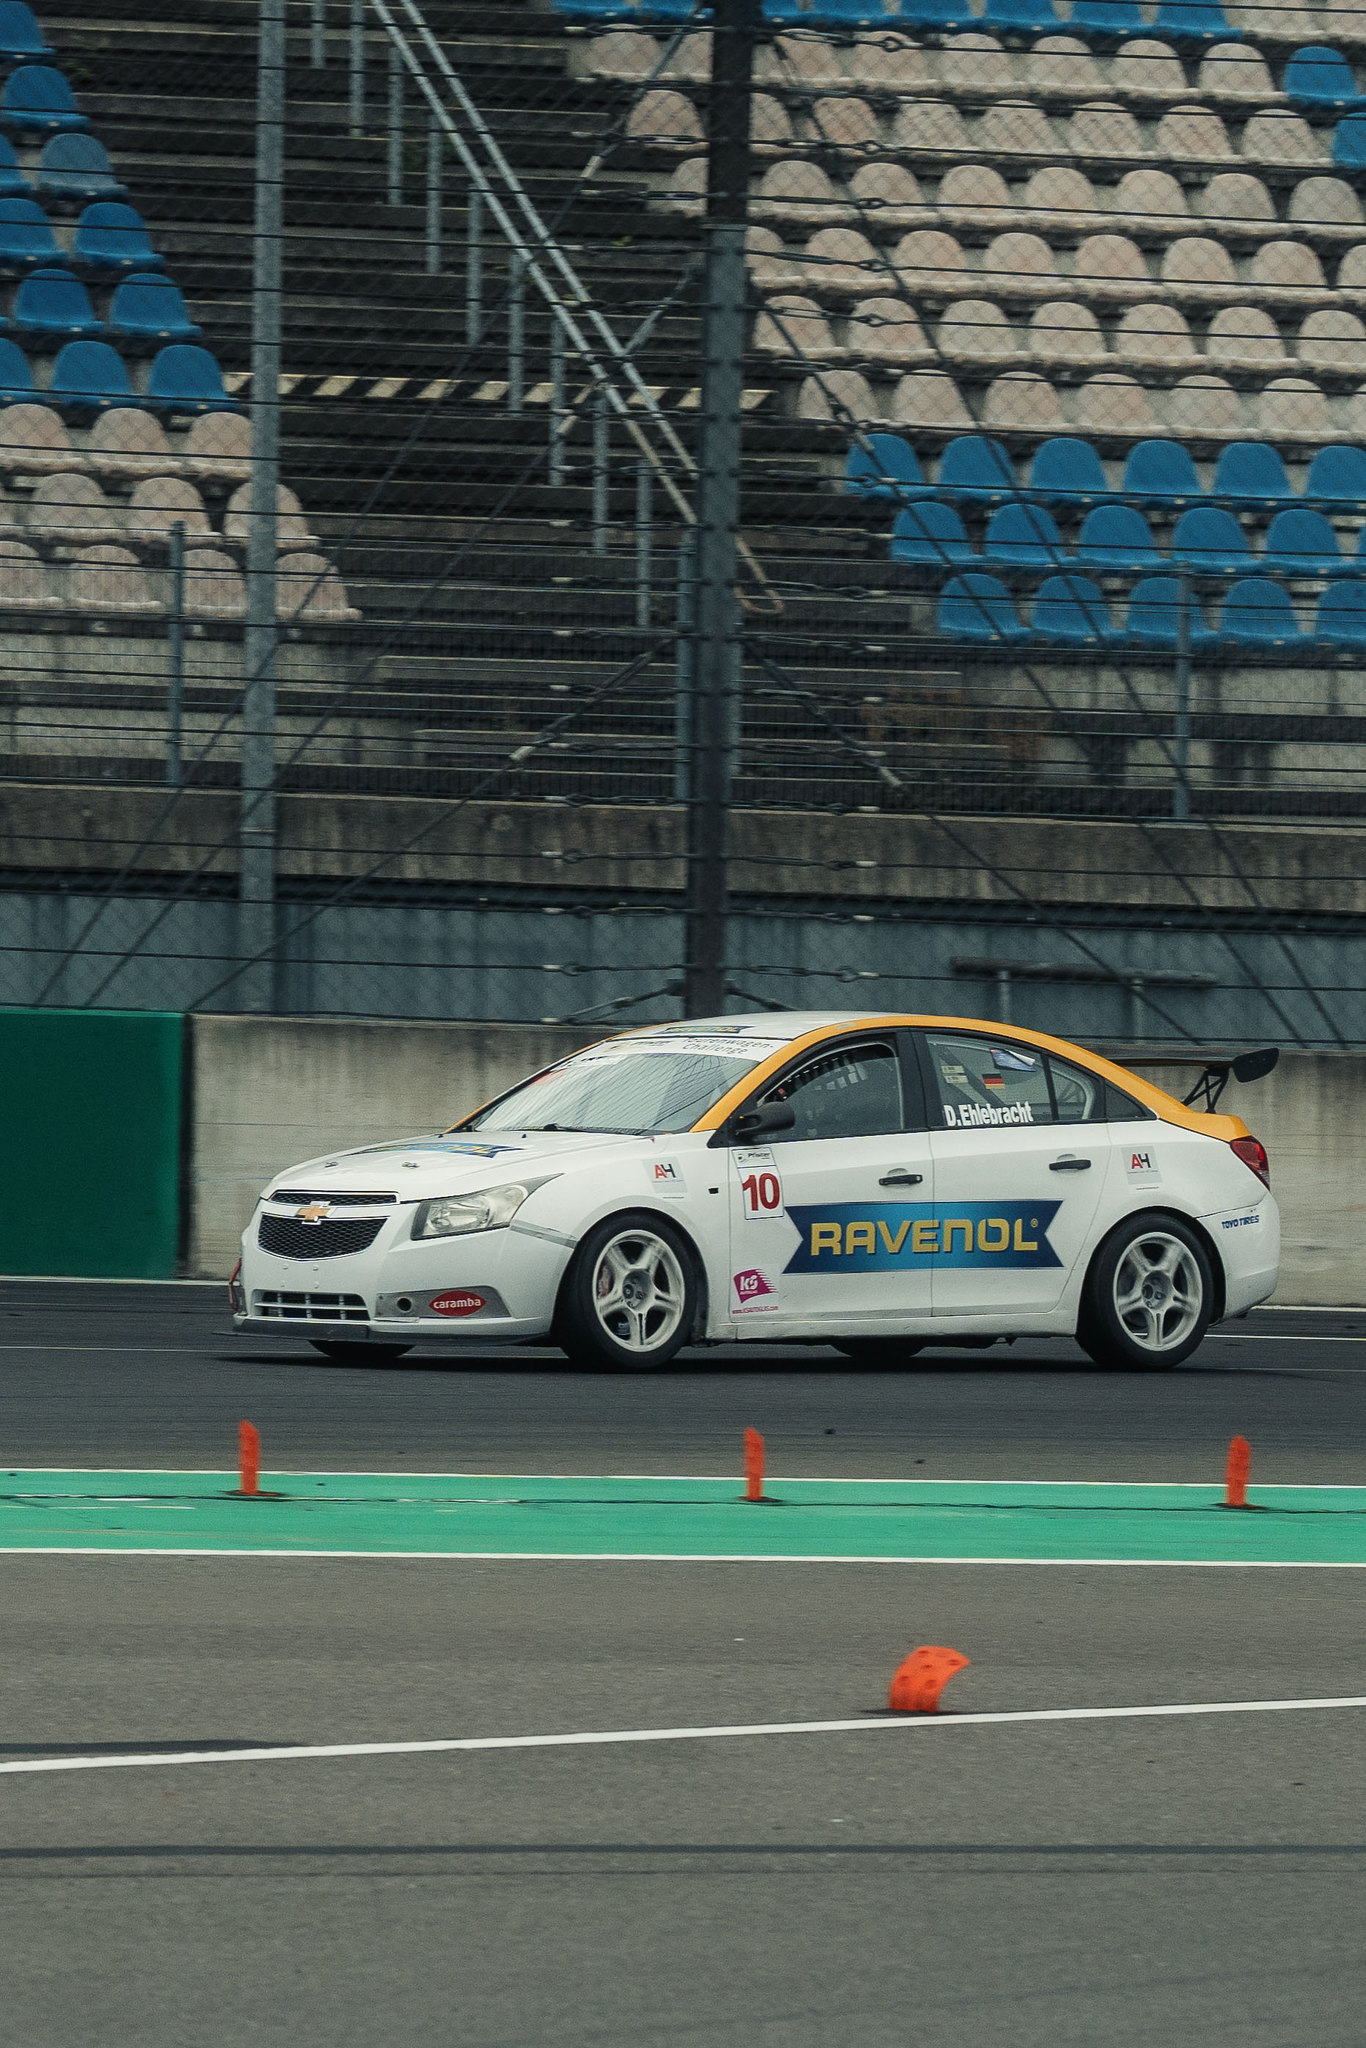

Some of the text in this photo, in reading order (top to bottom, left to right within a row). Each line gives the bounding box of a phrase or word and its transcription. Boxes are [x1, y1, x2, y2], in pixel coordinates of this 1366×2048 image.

[943, 1101, 1034, 1126] D.Ehlebracht
[742, 1173, 780, 1211] 10
[1222, 1215, 1259, 1229] TOYO TIRES
[433, 1298, 481, 1308] caramba
